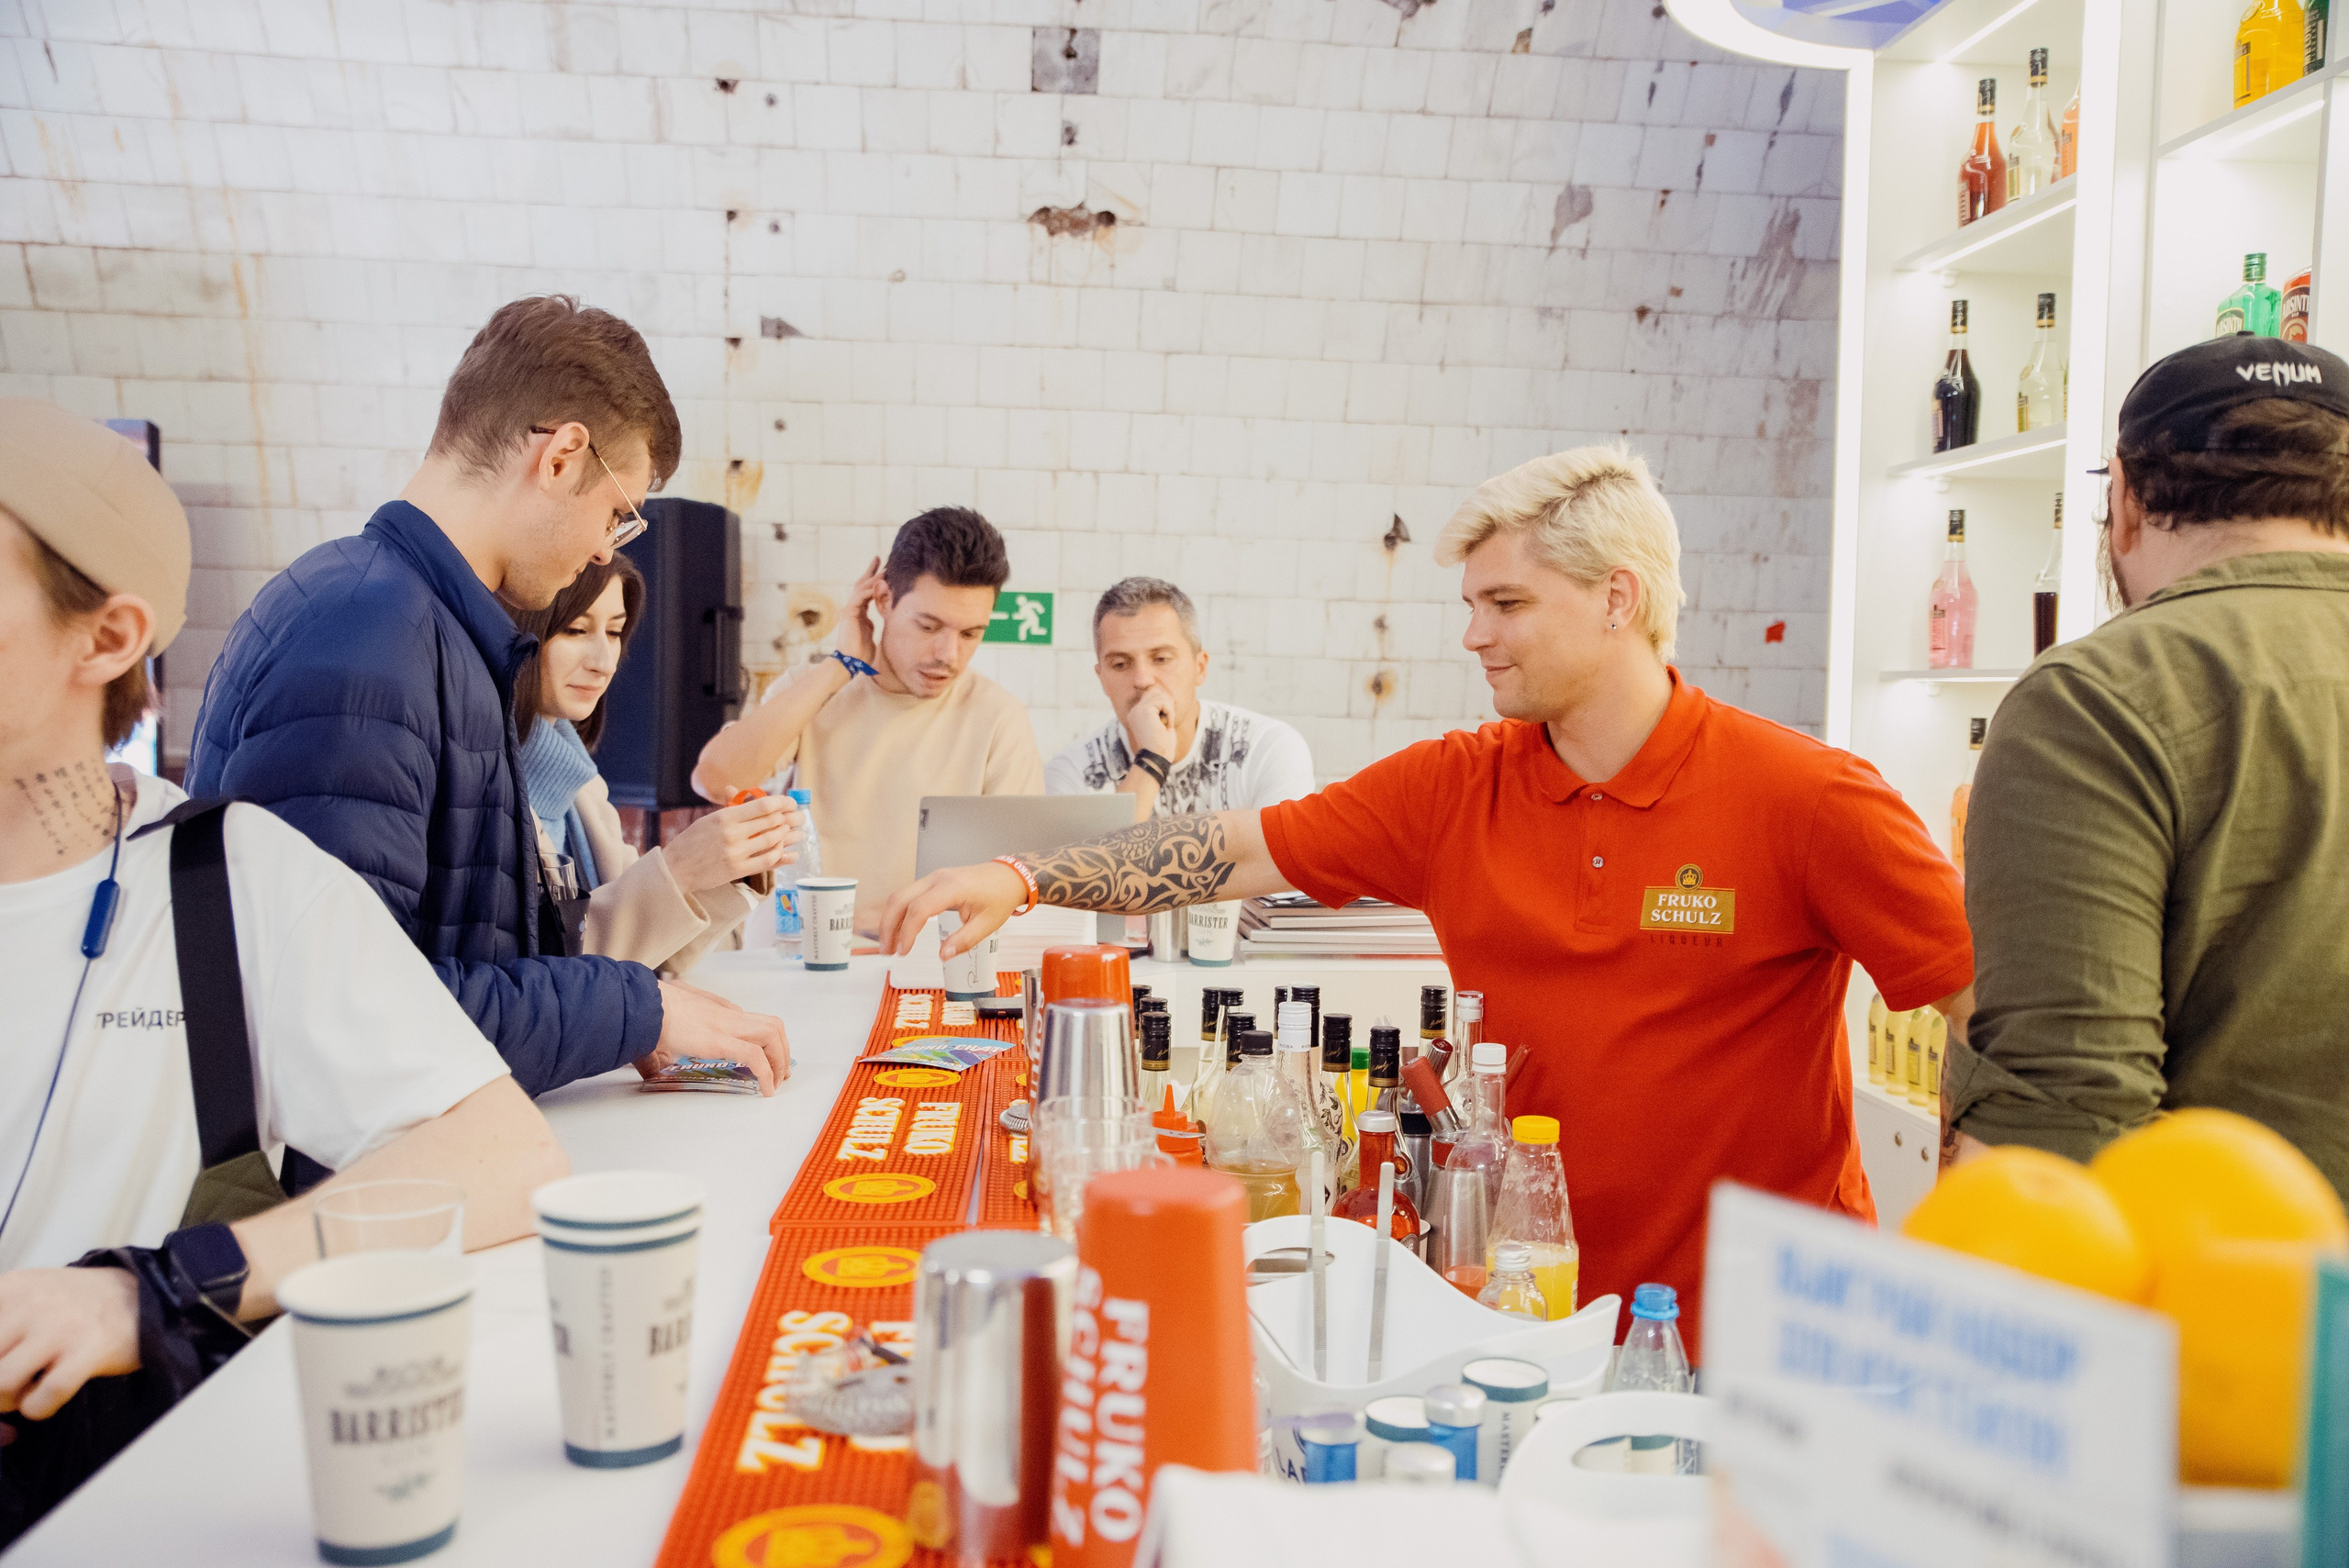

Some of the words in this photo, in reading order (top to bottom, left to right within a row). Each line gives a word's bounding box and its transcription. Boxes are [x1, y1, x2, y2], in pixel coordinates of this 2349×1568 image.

[2235, 361, 2322, 386] VENUM
[1657, 893, 1717, 909] FRUKO
[1650, 908, 1723, 925] SCHULZ
[1649, 934, 1723, 947] LIQUEUR
[835, 1096, 906, 1162] SCHULZ
[904, 1101, 963, 1155] FRUKO
[1088, 1295, 1151, 1543] FRUKO
